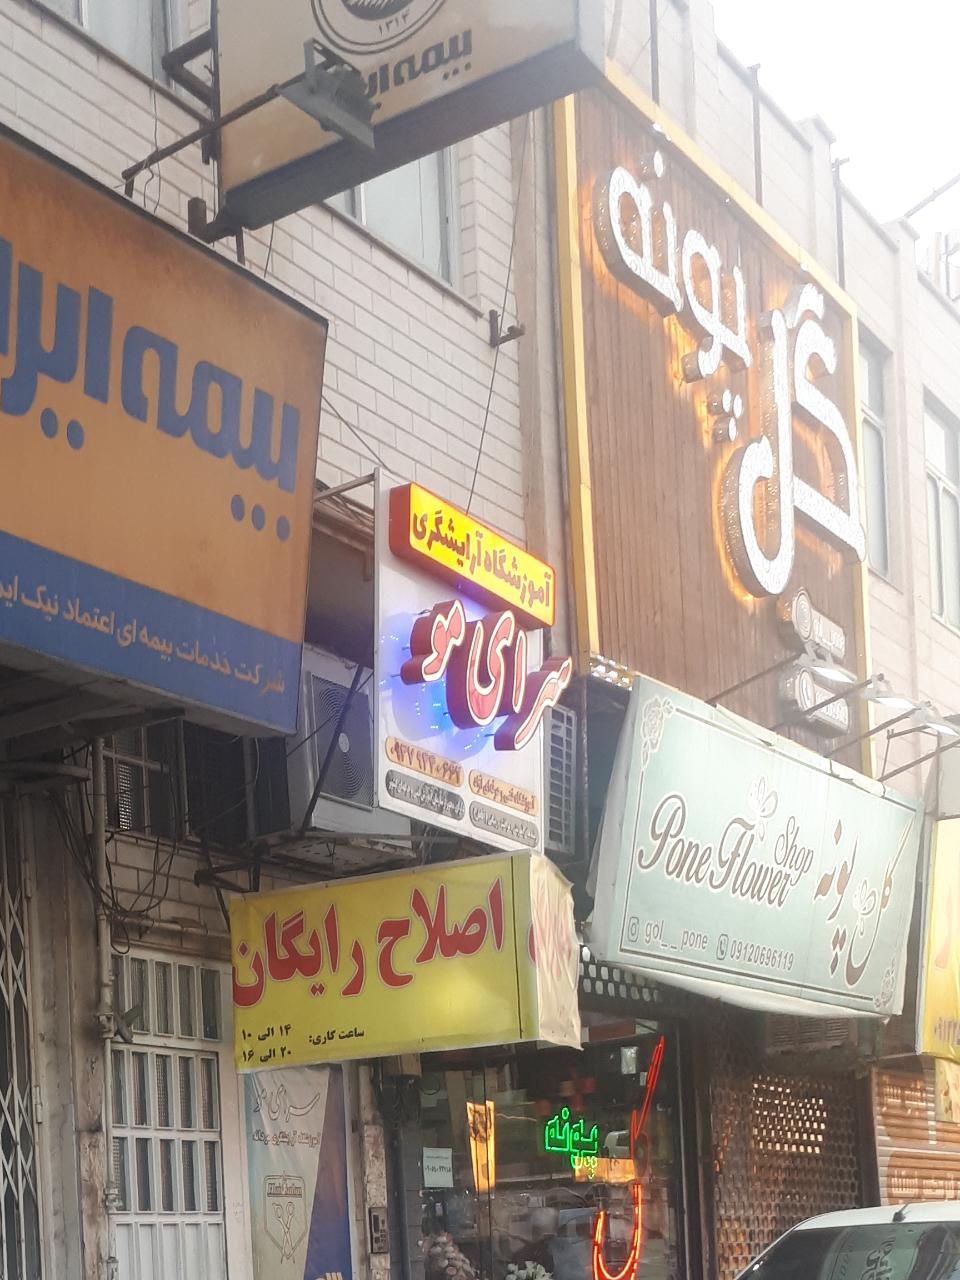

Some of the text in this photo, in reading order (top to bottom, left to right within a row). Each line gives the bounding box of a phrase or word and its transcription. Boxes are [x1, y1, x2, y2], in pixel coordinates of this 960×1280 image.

[603, 149, 868, 597] گل پونه
[121, 323, 302, 542] بیمه
[412, 509, 552, 609] آموزشگاه آرایشگری
[20, 584, 60, 622] نیک
[62, 597, 115, 637] اعتماد
[116, 618, 137, 648] ای
[138, 623, 174, 662] بیمه
[175, 639, 233, 677] خدمات
[234, 663, 286, 695] شرکت
[637, 793, 712, 885] Pone
[709, 816, 792, 908] Flower
[773, 814, 814, 886] Shop
[376, 876, 505, 989] اصلاح
[232, 902, 367, 1009] رایگان
[257, 1026, 275, 1041] الی
[338, 1027, 366, 1041] ساعت
[258, 1048, 277, 1063] الی
